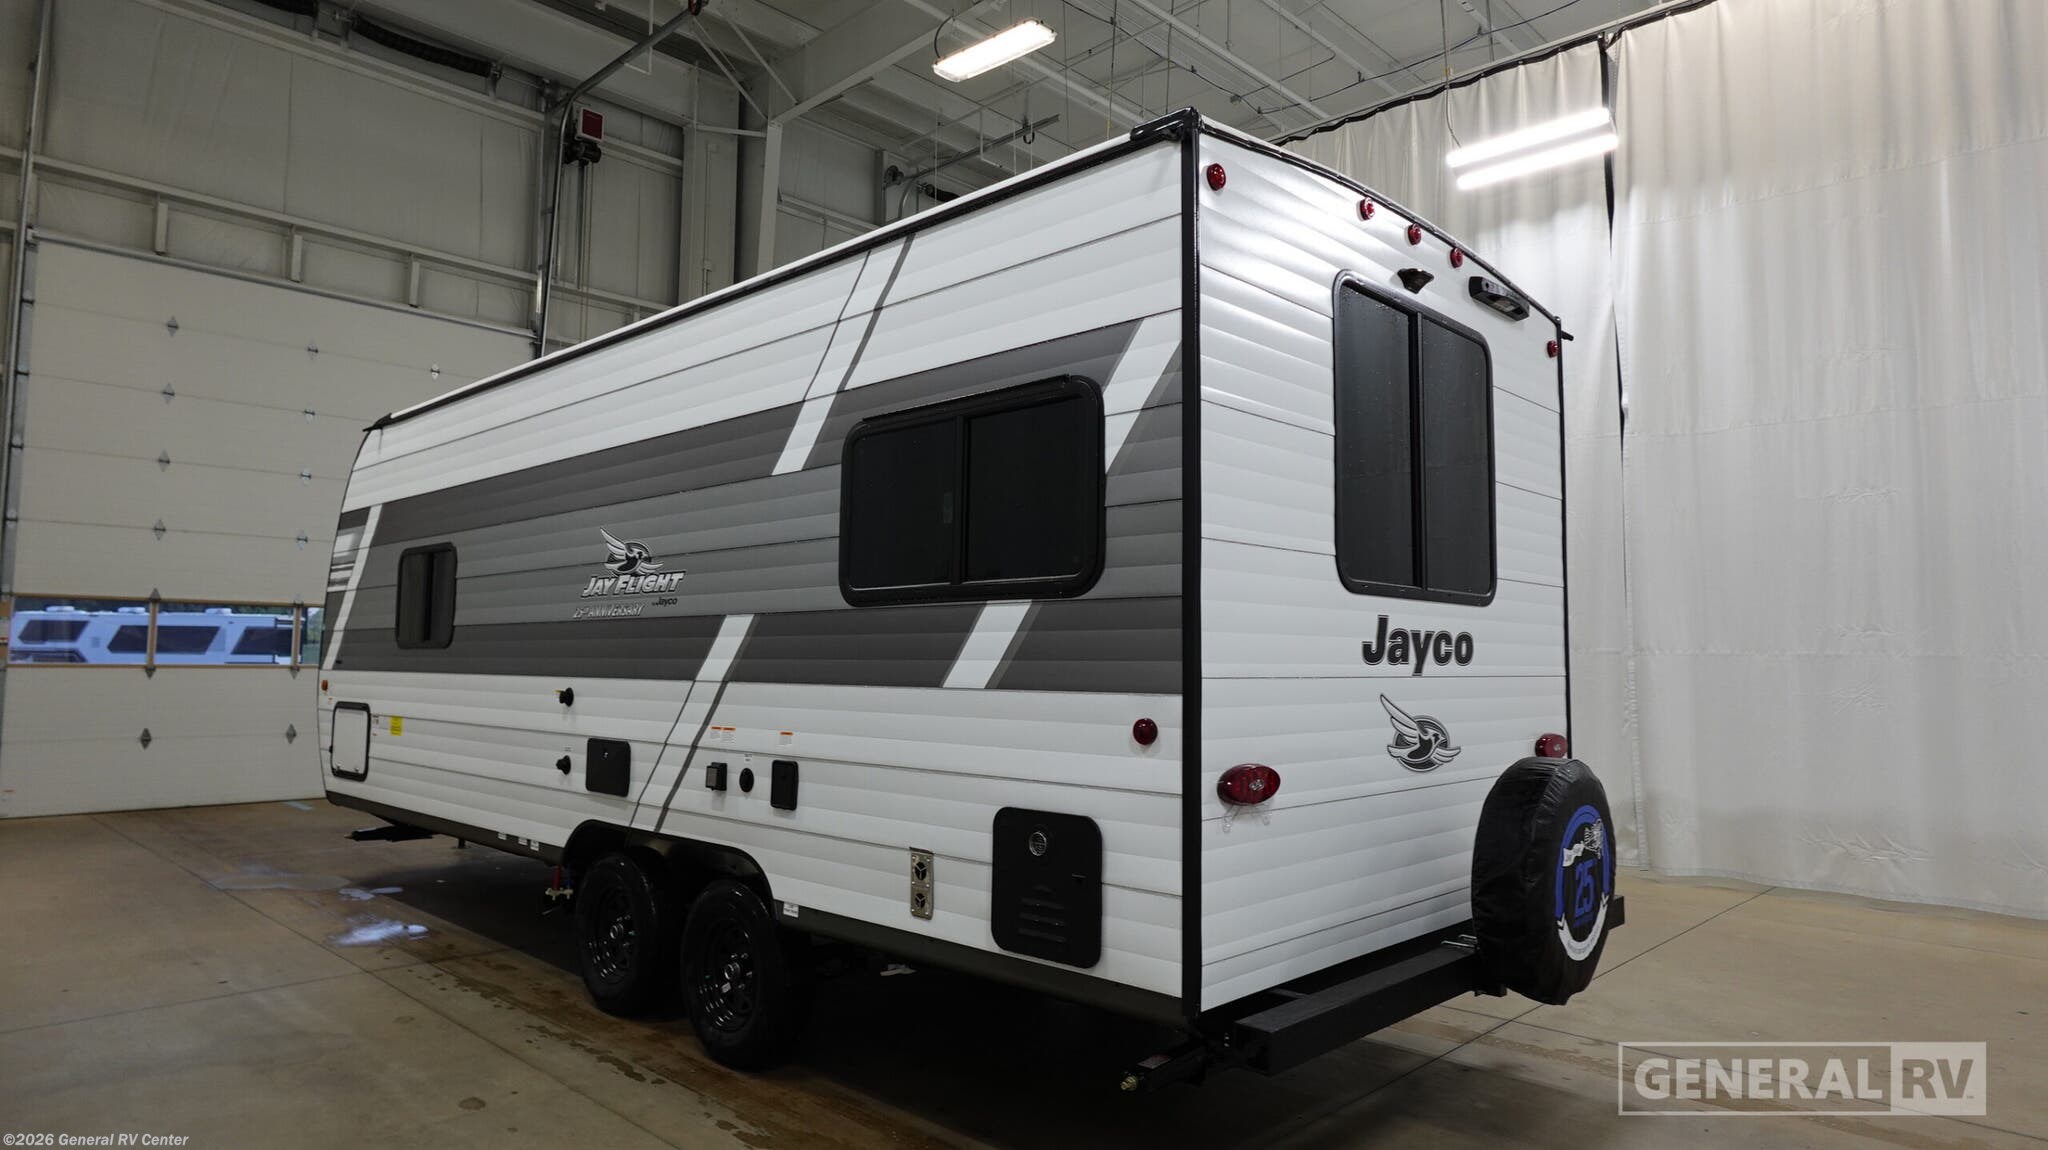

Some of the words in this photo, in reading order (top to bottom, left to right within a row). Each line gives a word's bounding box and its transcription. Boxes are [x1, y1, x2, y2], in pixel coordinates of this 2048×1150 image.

[581, 576, 616, 598] JAY
[613, 571, 687, 595] FLIGHT
[1362, 615, 1473, 676] Jayco
[1574, 857, 1597, 917] 25
